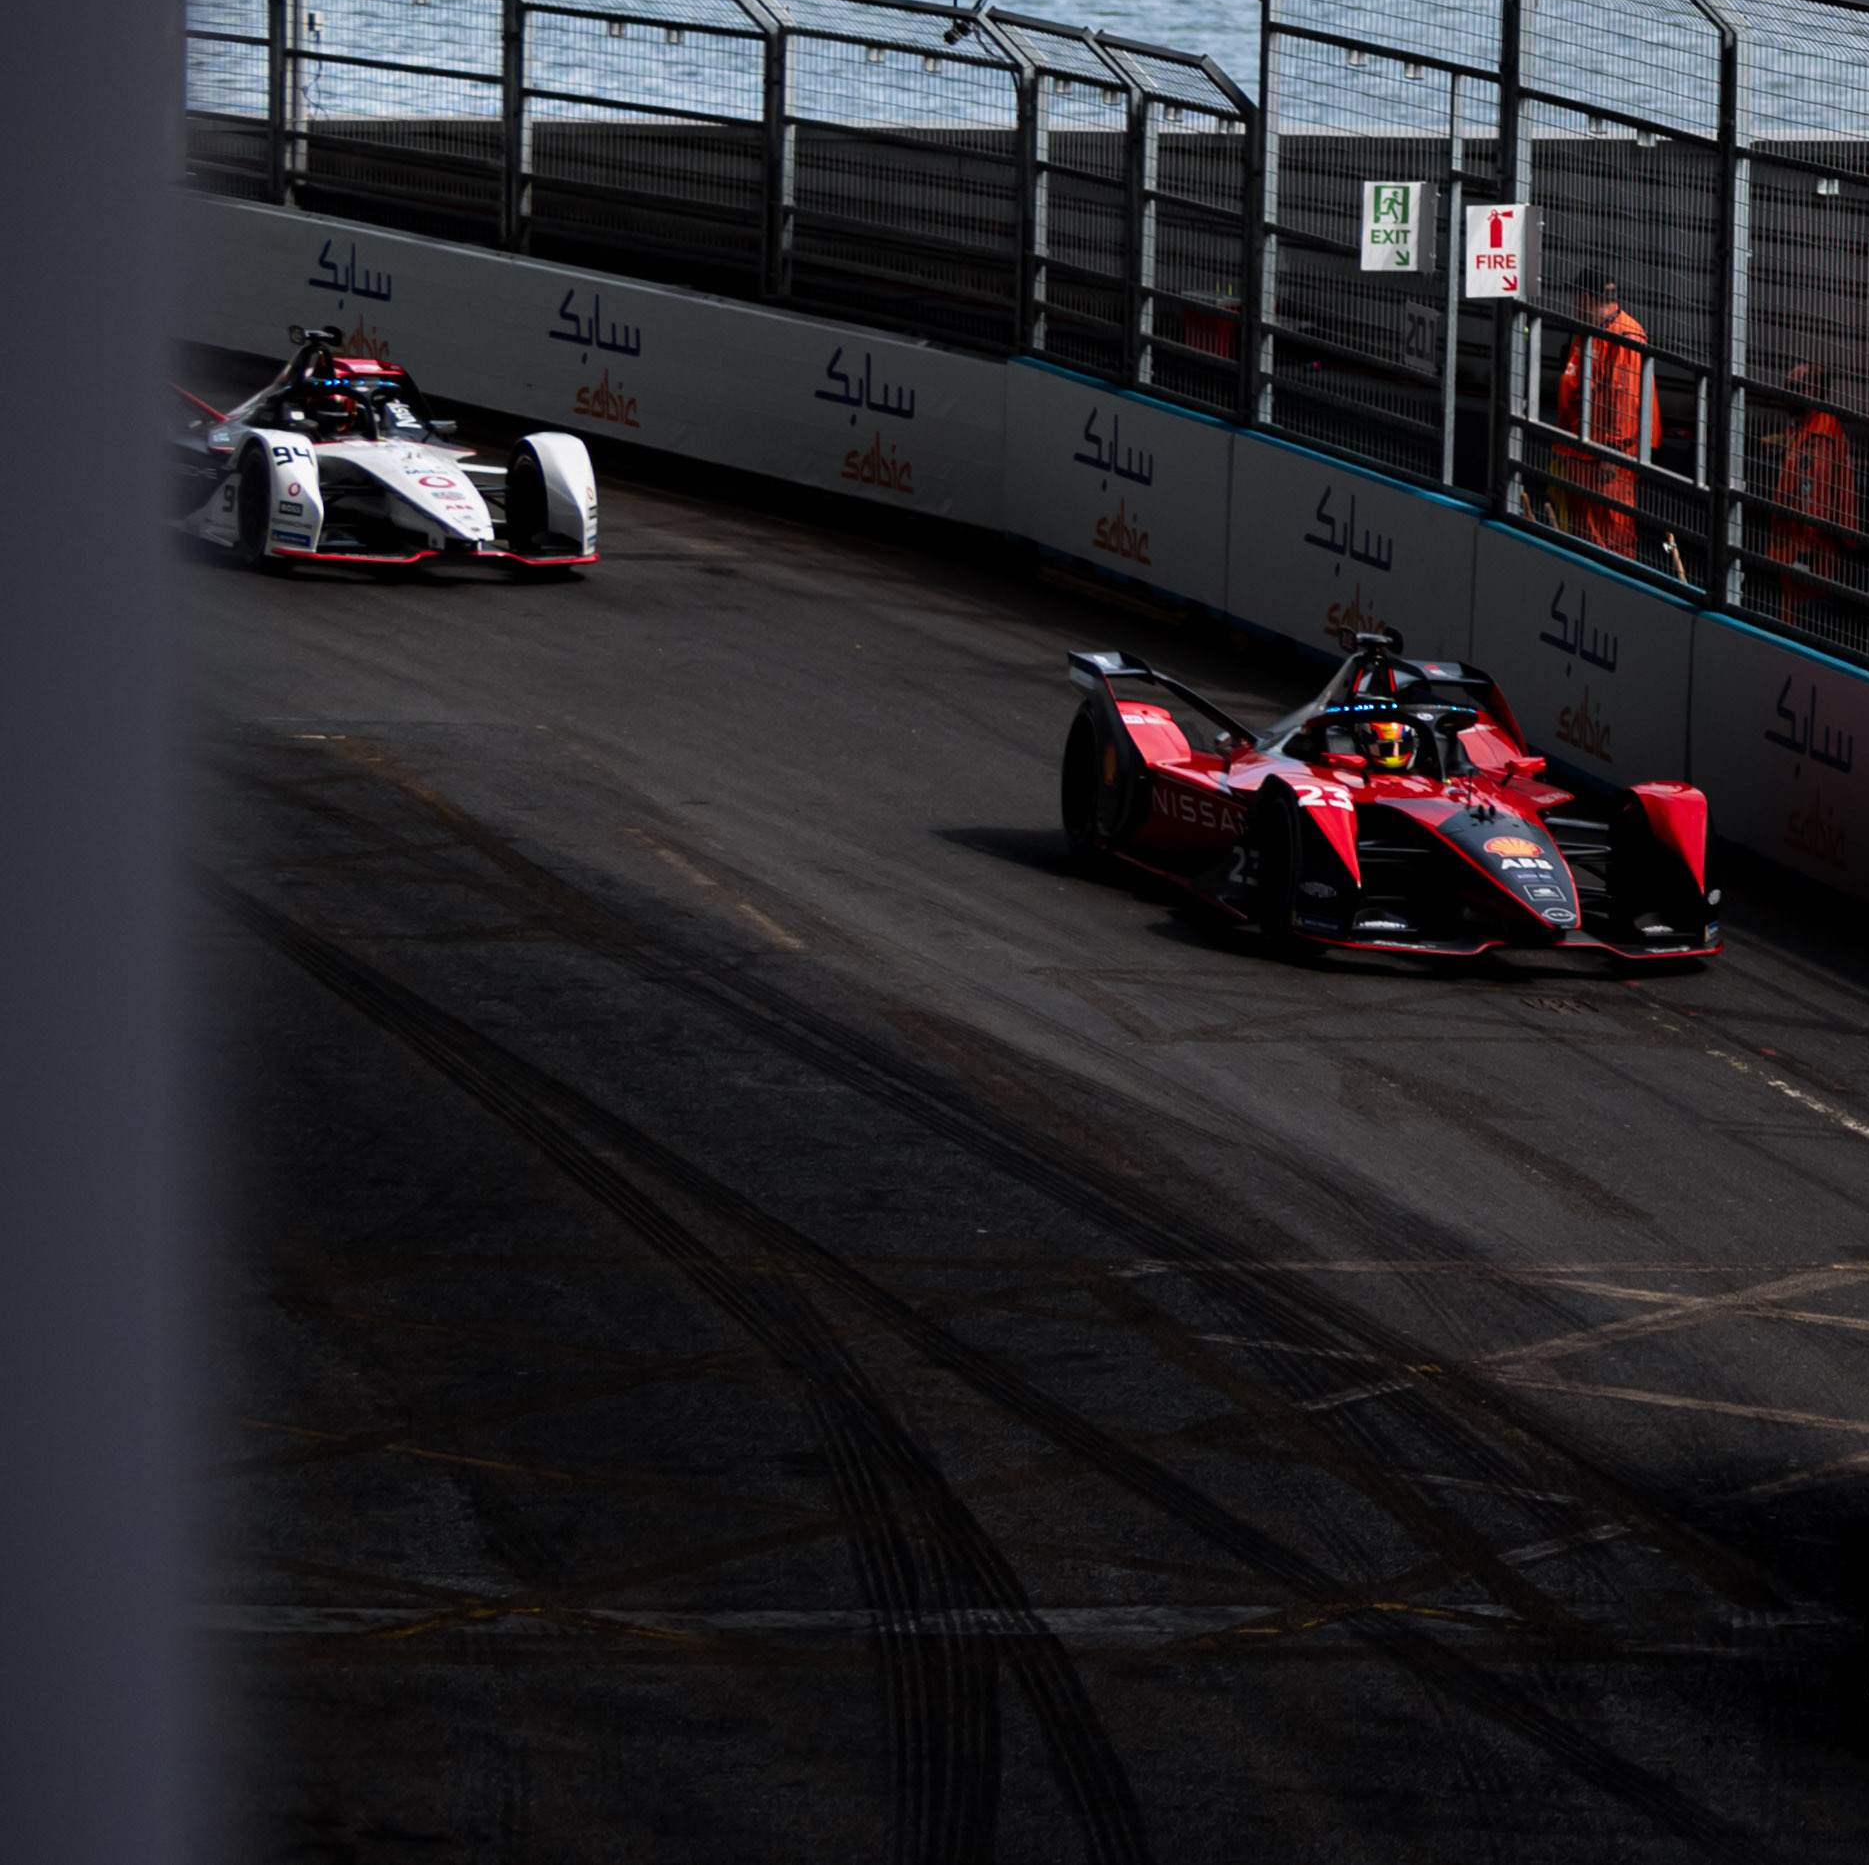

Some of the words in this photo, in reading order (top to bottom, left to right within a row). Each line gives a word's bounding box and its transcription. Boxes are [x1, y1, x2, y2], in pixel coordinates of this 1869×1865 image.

[1370, 229, 1411, 244] EXIT
[1476, 254, 1517, 269] FIRE
[308, 239, 391, 309] سابك
[548, 288, 641, 364] سابك
[573, 369, 641, 429] sabic
[813, 346, 916, 427] سابك
[272, 445, 315, 467] 94
[841, 431, 915, 496] sabic
[1073, 407, 1154, 492] سابك
[1093, 497, 1152, 567] sabic
[1303, 484, 1394, 577] سابك
[1538, 580, 1618, 678] سابك
[1555, 685, 1613, 764] sabic
[1297, 783, 1355, 812] 23
[1784, 787, 1848, 871] sabic
[1501, 857, 1554, 870] ABB
